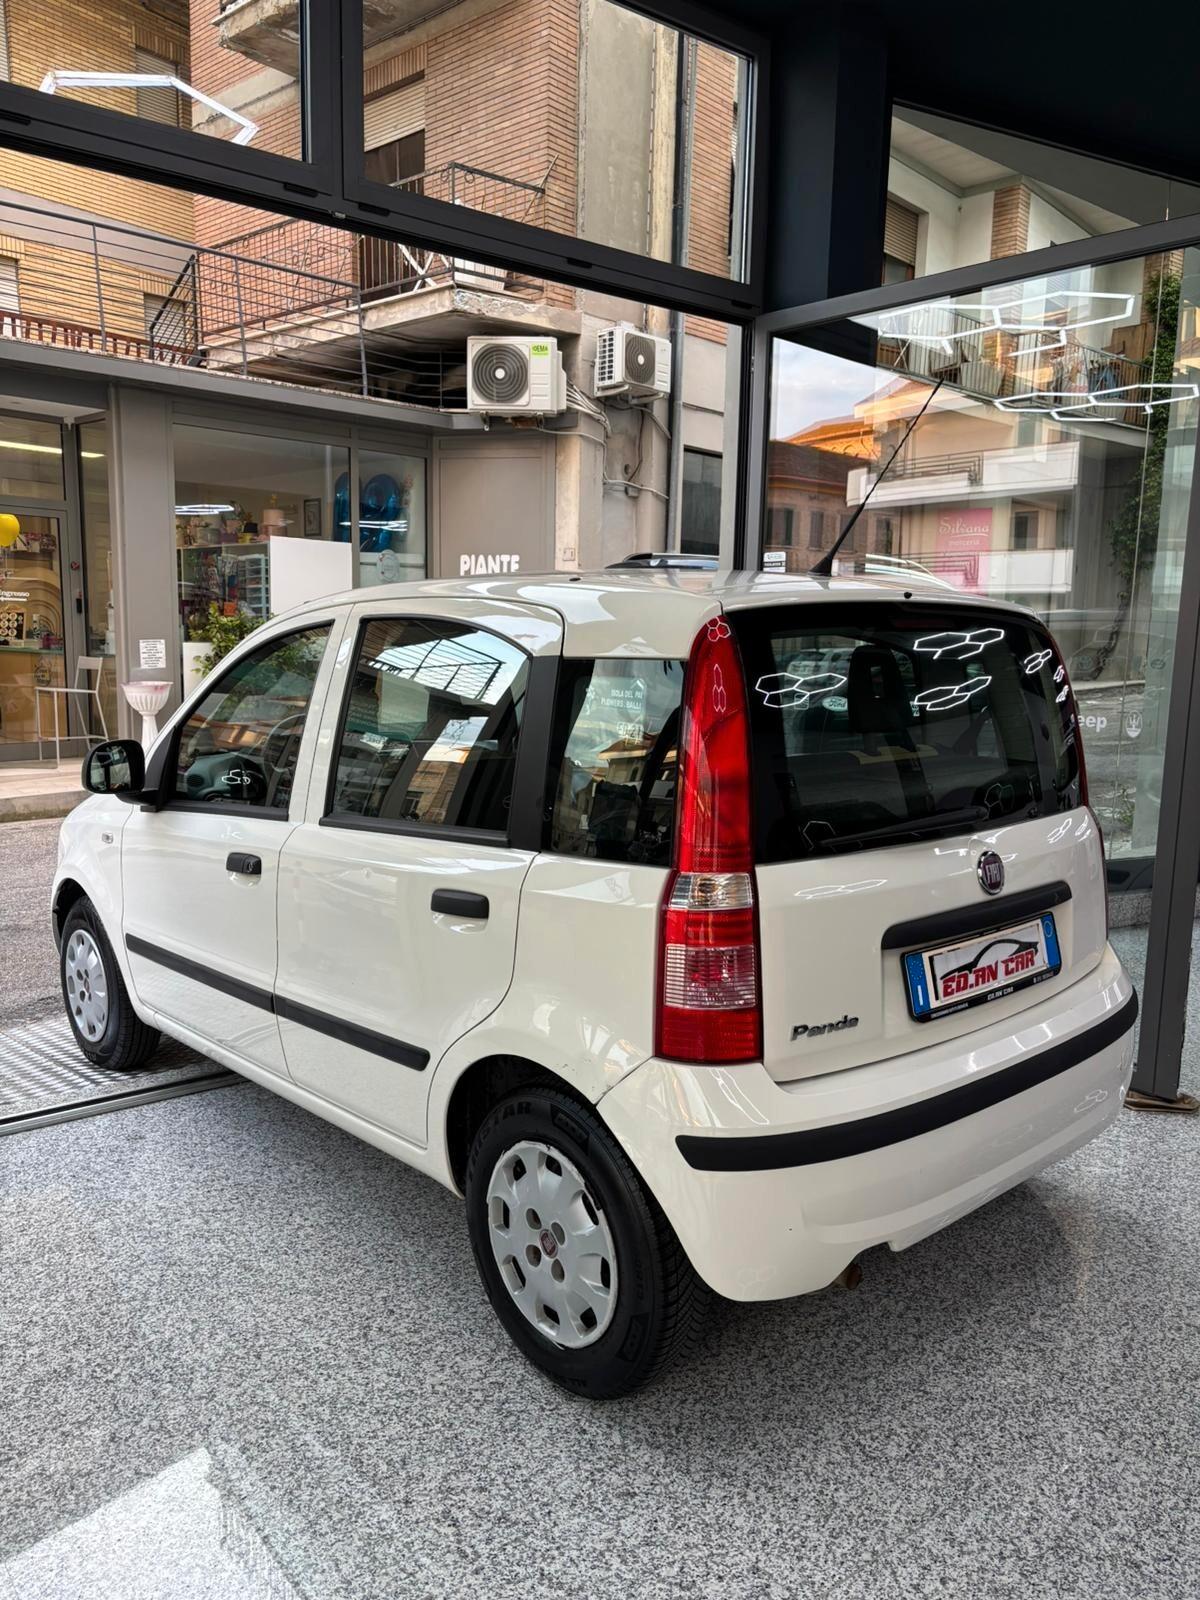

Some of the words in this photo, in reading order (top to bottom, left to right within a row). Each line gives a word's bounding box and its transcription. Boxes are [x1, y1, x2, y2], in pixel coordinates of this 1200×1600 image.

[460, 553, 520, 577] PIANTE
[1077, 715, 1107, 733] eep
[942, 960, 999, 999] ED.AN
[1001, 949, 1036, 977] CAR
[790, 1014, 860, 1042] Panda
